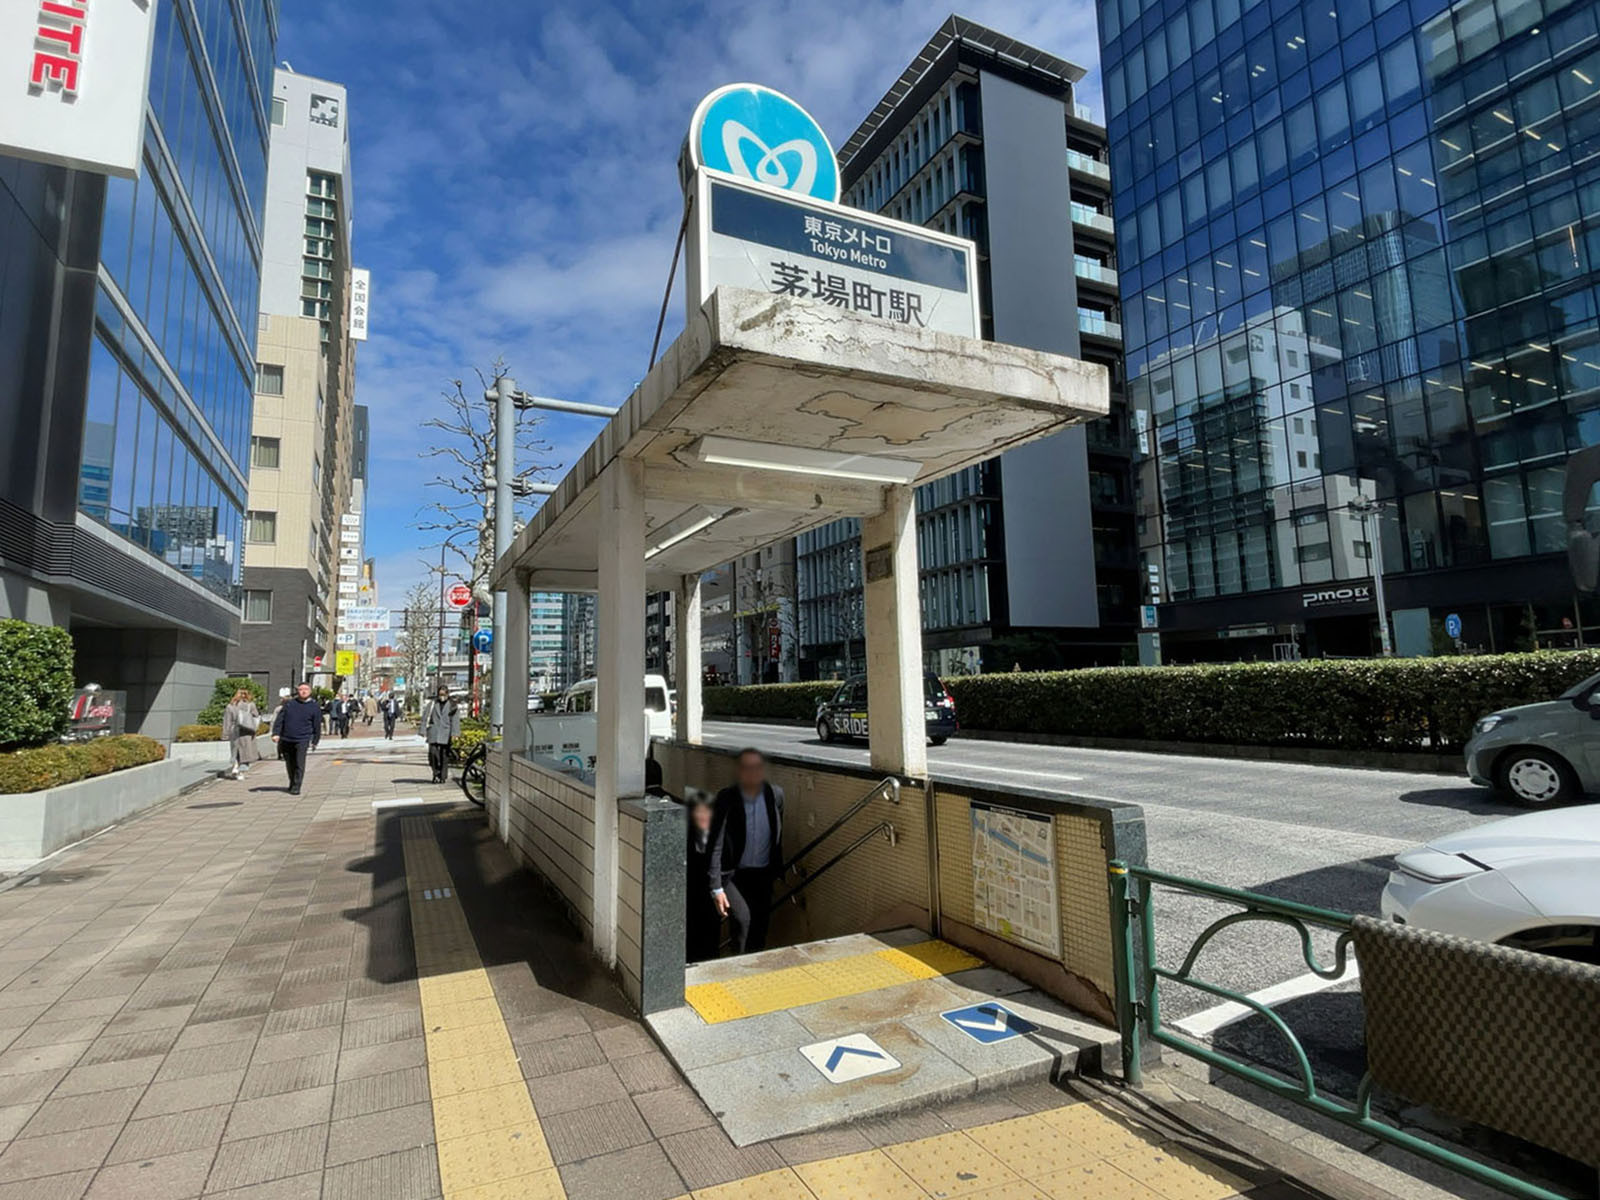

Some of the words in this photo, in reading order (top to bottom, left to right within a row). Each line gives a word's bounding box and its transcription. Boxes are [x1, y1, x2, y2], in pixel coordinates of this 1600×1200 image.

[31, 0, 88, 91] ITE
[803, 214, 892, 255] 東京メトロ
[810, 238, 848, 260] Tokyo
[850, 248, 888, 270] Metro
[769, 261, 926, 328] 茅場町駅
[1354, 586, 1369, 597] EX
